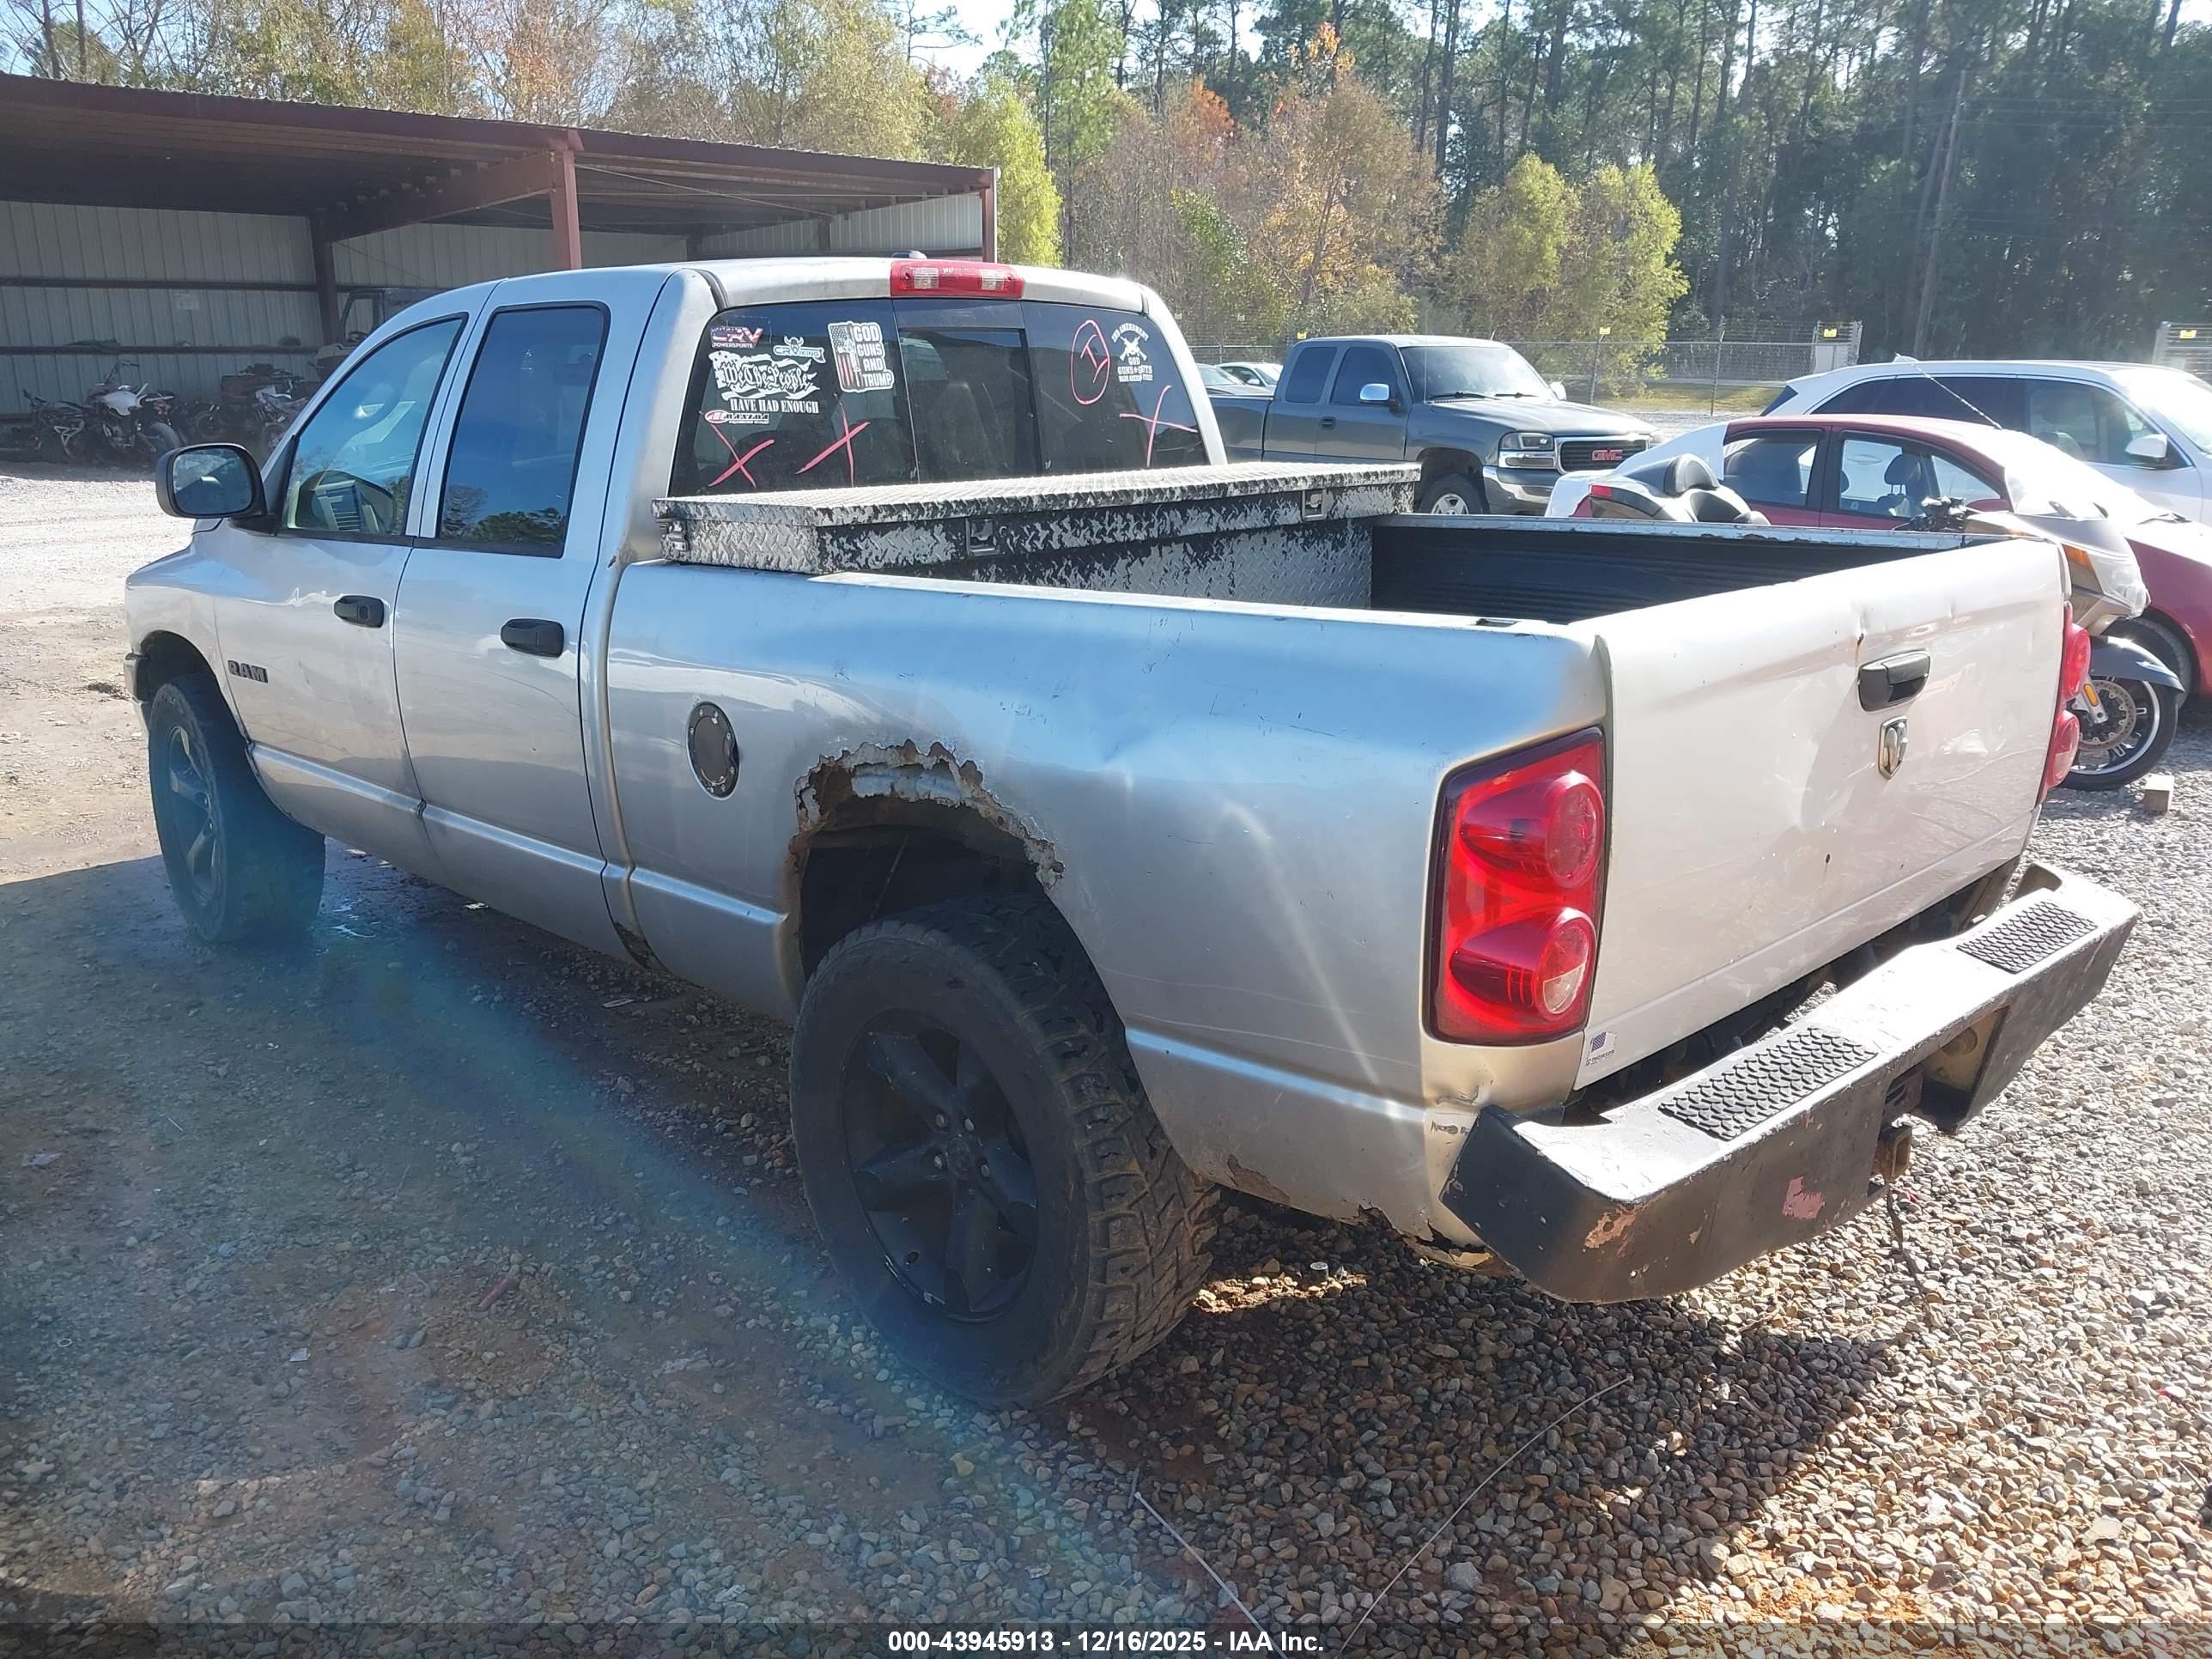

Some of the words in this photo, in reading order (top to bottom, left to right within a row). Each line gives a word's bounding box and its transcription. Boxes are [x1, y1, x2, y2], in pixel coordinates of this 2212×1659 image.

[854, 325, 880, 343] GOD
[857, 343, 883, 357] GUNS
[863, 357, 884, 372] AND
[1127, 357, 1140, 366] GOD
[768, 364, 809, 392] People
[862, 373, 892, 387] TRUMP
[730, 398, 757, 411] HAVE
[758, 399, 780, 412] HAD
[781, 399, 819, 414] ENOUGH
[1592, 449, 1623, 461] GMC
[227, 659, 269, 684] RAM
